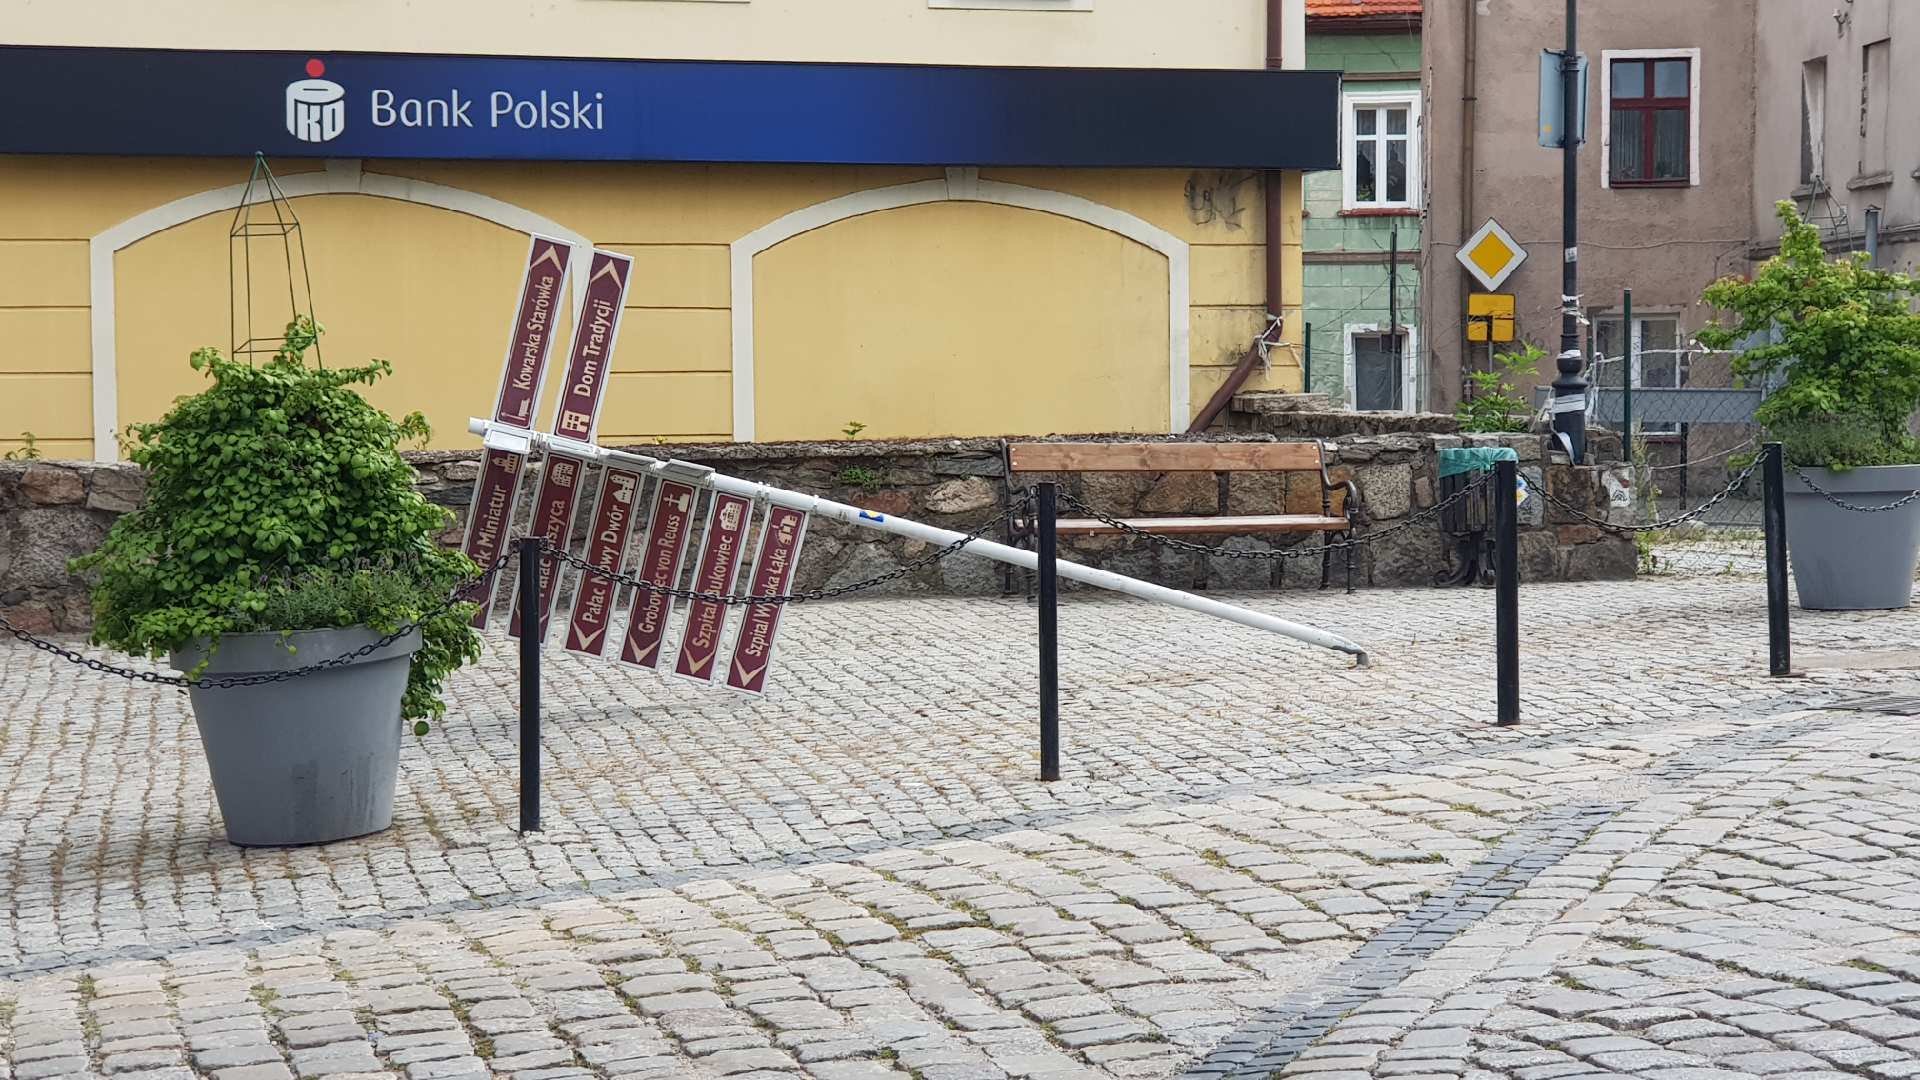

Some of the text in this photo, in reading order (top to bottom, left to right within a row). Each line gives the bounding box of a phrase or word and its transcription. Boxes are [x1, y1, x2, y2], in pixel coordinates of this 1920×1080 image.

[371, 89, 603, 129] Bank Polski
[512, 275, 555, 390] Kowarska Starówka
[573, 300, 615, 397] Dom Tradycji
[477, 484, 508, 548] Miniatur
[582, 588, 606, 624] Pałac
[601, 504, 625, 544] Dwór
[638, 514, 681, 634] Grobowec von Reuss
[692, 602, 719, 649] Szpital
[745, 548, 790, 657] Szpital Wyoka Łąka
